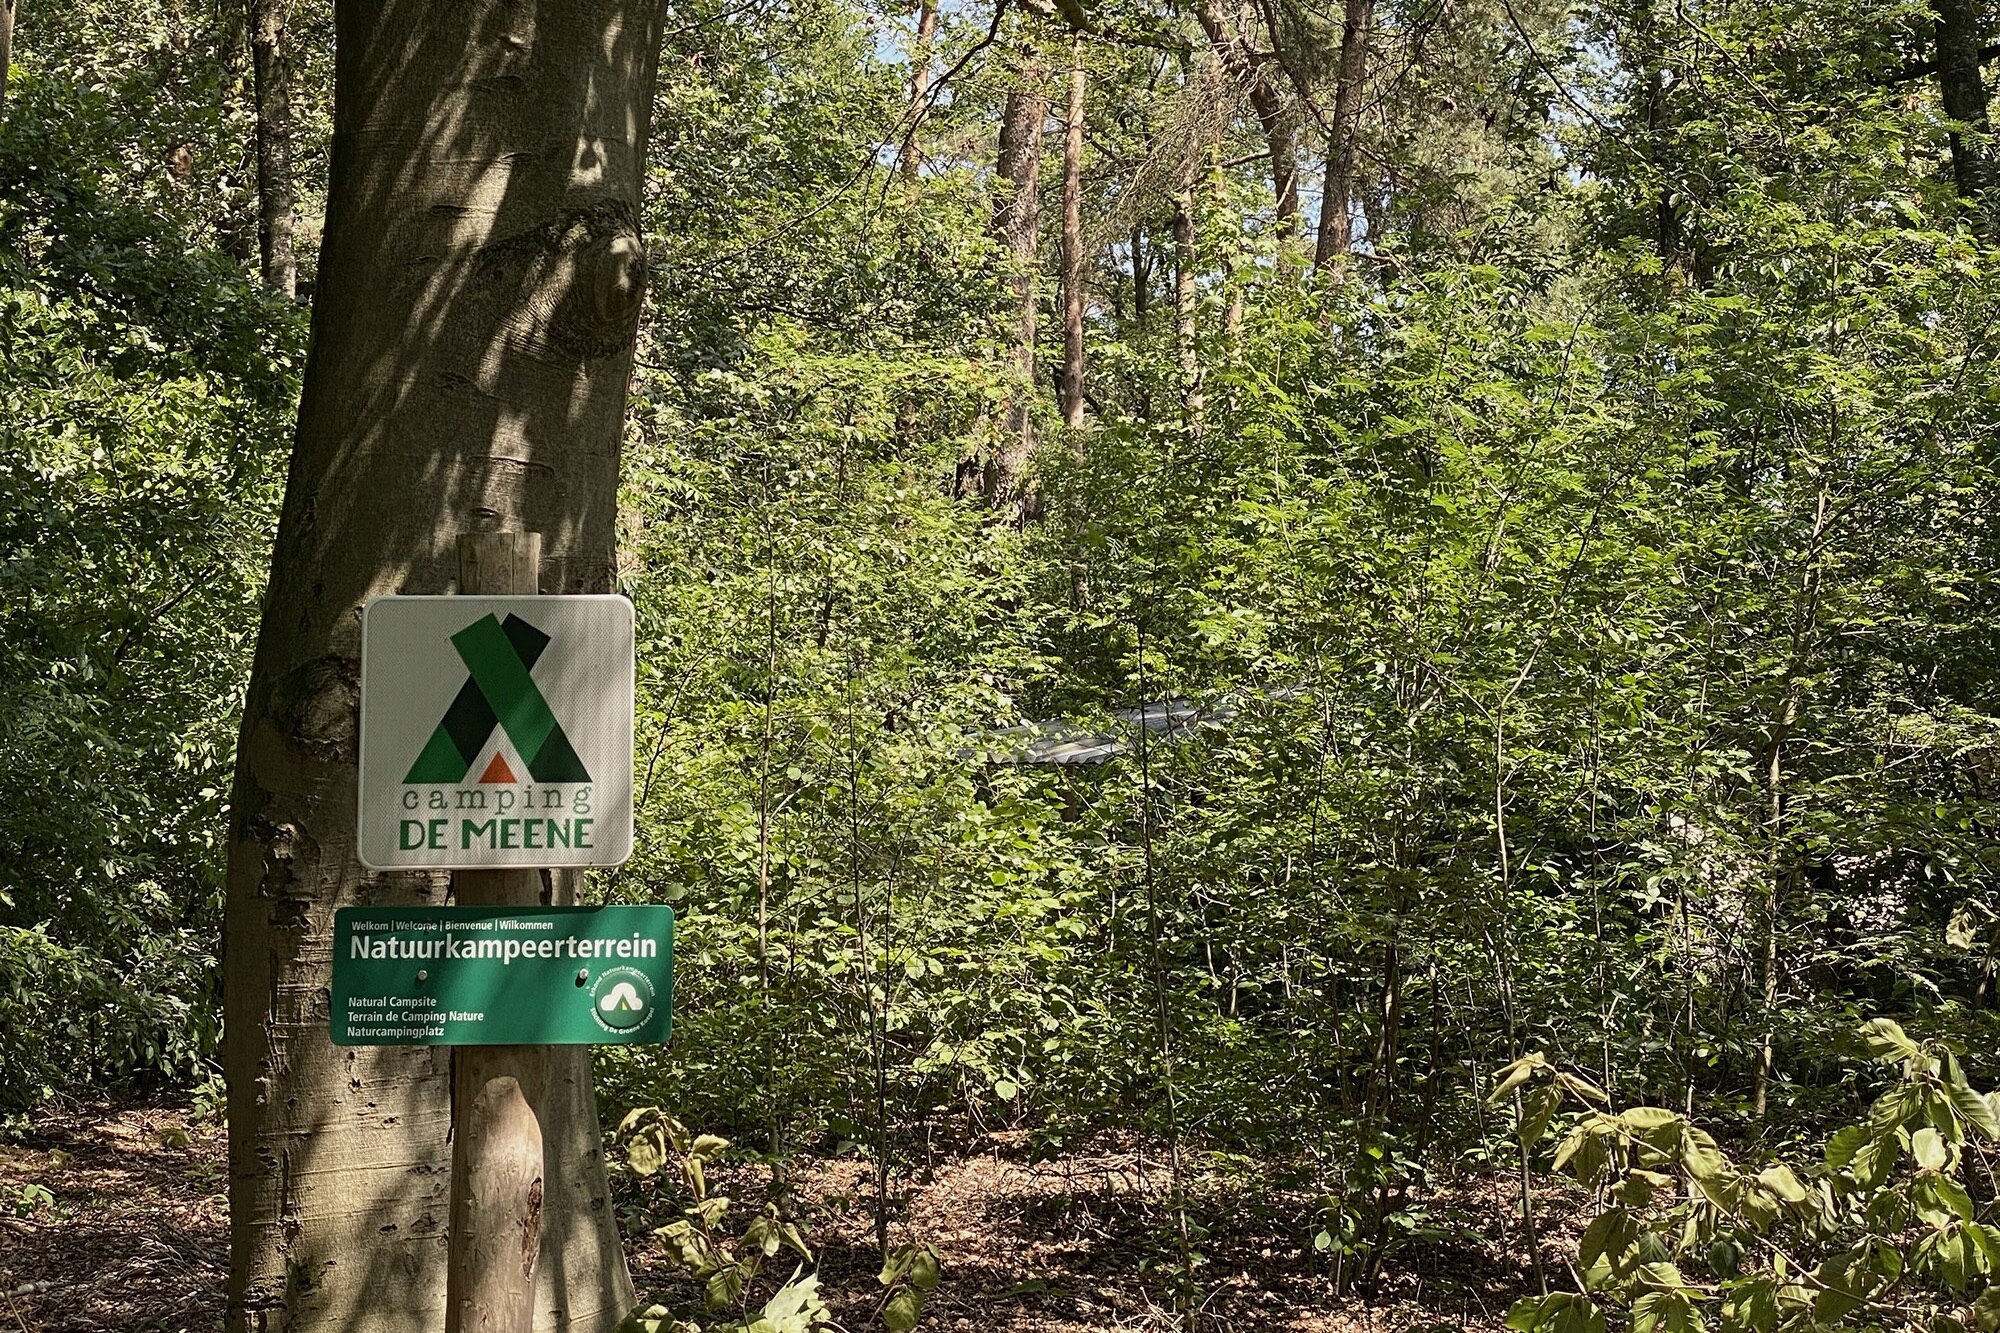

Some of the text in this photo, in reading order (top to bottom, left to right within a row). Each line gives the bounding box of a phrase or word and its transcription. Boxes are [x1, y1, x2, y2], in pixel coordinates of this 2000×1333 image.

[402, 785, 592, 815] camping
[400, 818, 594, 850] DE MEENE
[351, 921, 389, 931] Welkom
[396, 921, 437, 931] Welcome
[445, 920, 493, 930] Bienvenue
[350, 932, 657, 965] Natuurkampeerterrein
[348, 997, 437, 1008] Natural Campsite
[348, 1011, 484, 1024] Terrain de Camping Nature
[347, 1026, 445, 1038] Naturcampingplatz
